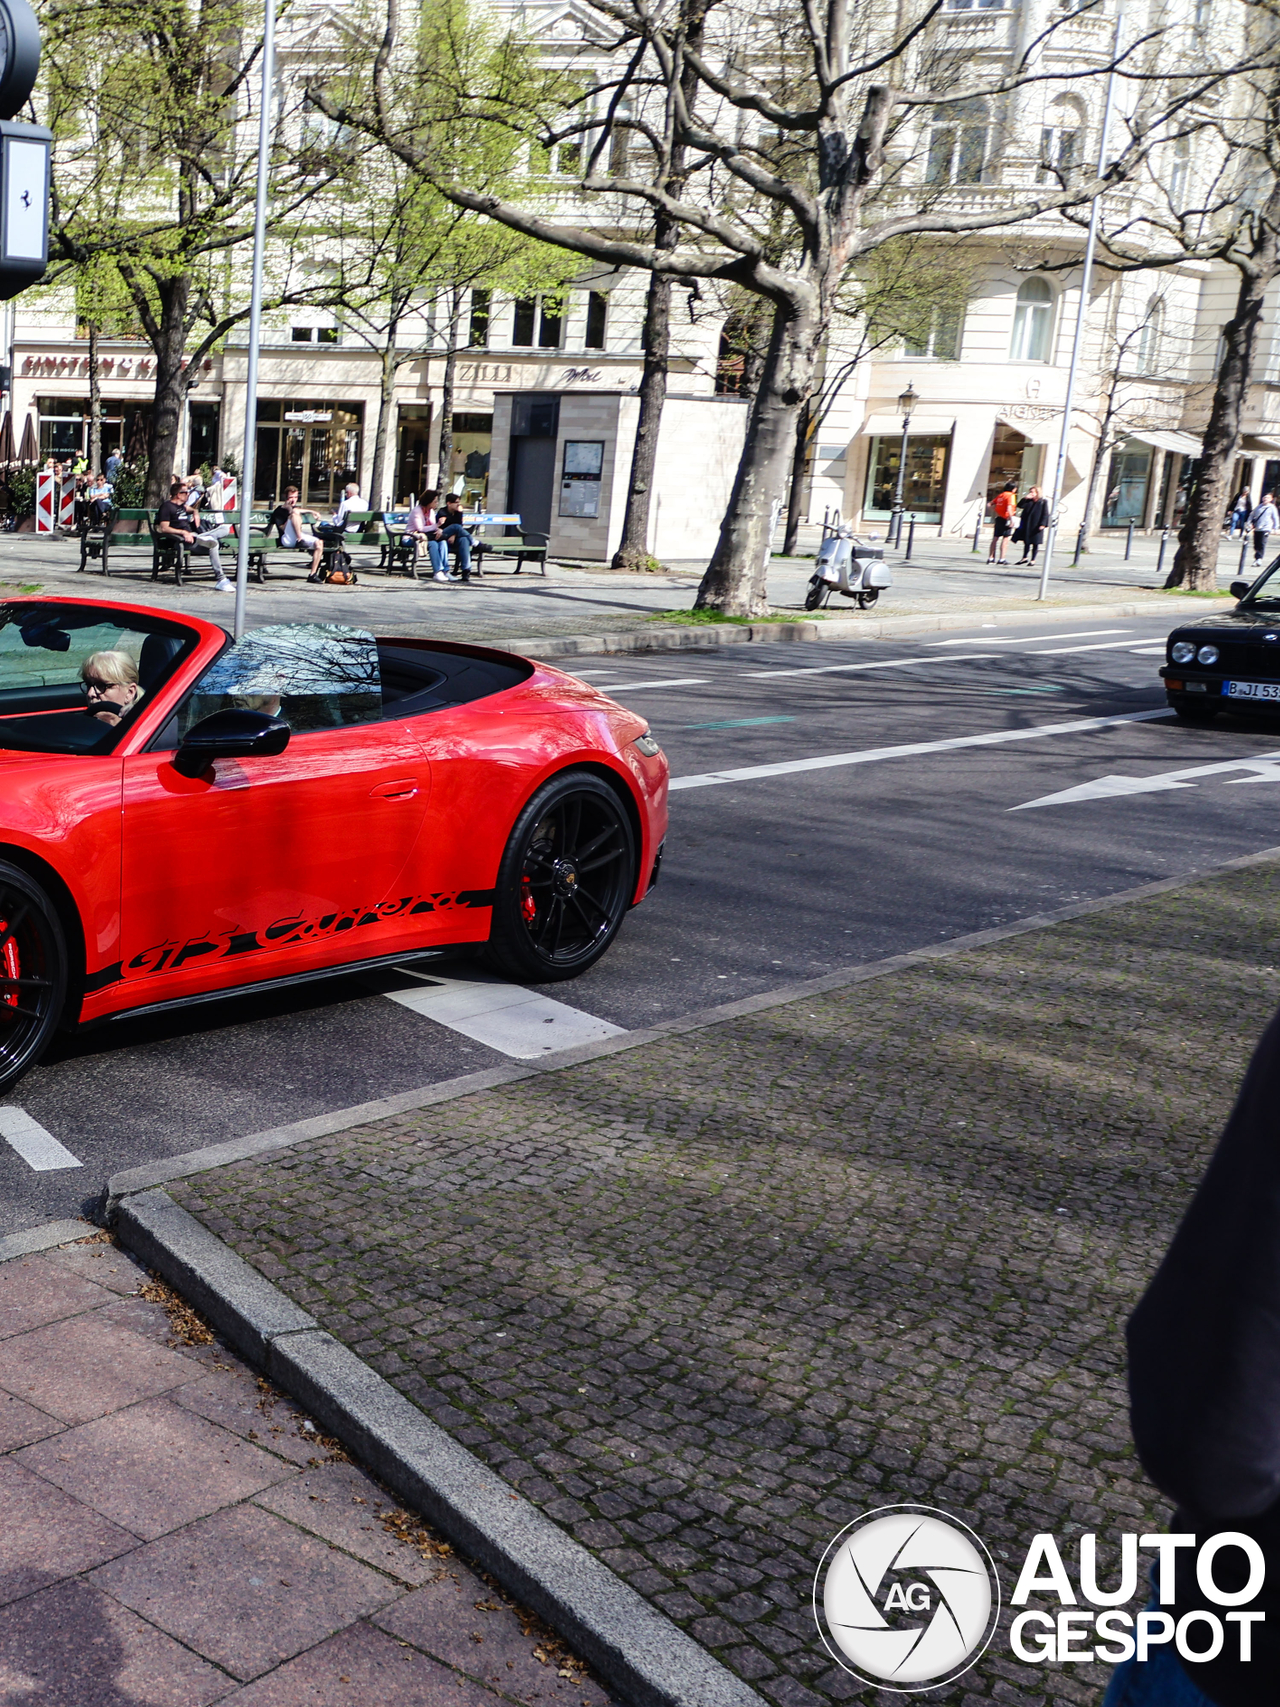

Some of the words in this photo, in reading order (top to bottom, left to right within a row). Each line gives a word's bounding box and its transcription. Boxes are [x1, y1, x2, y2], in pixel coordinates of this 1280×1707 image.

[459, 364, 512, 382] ZILLI
[1229, 682, 1238, 695] B
[1262, 685, 1280, 699] 53
[120, 925, 239, 978] GTS
[255, 890, 473, 948] Carrera
[7, 942, 17, 980] PORSCH
